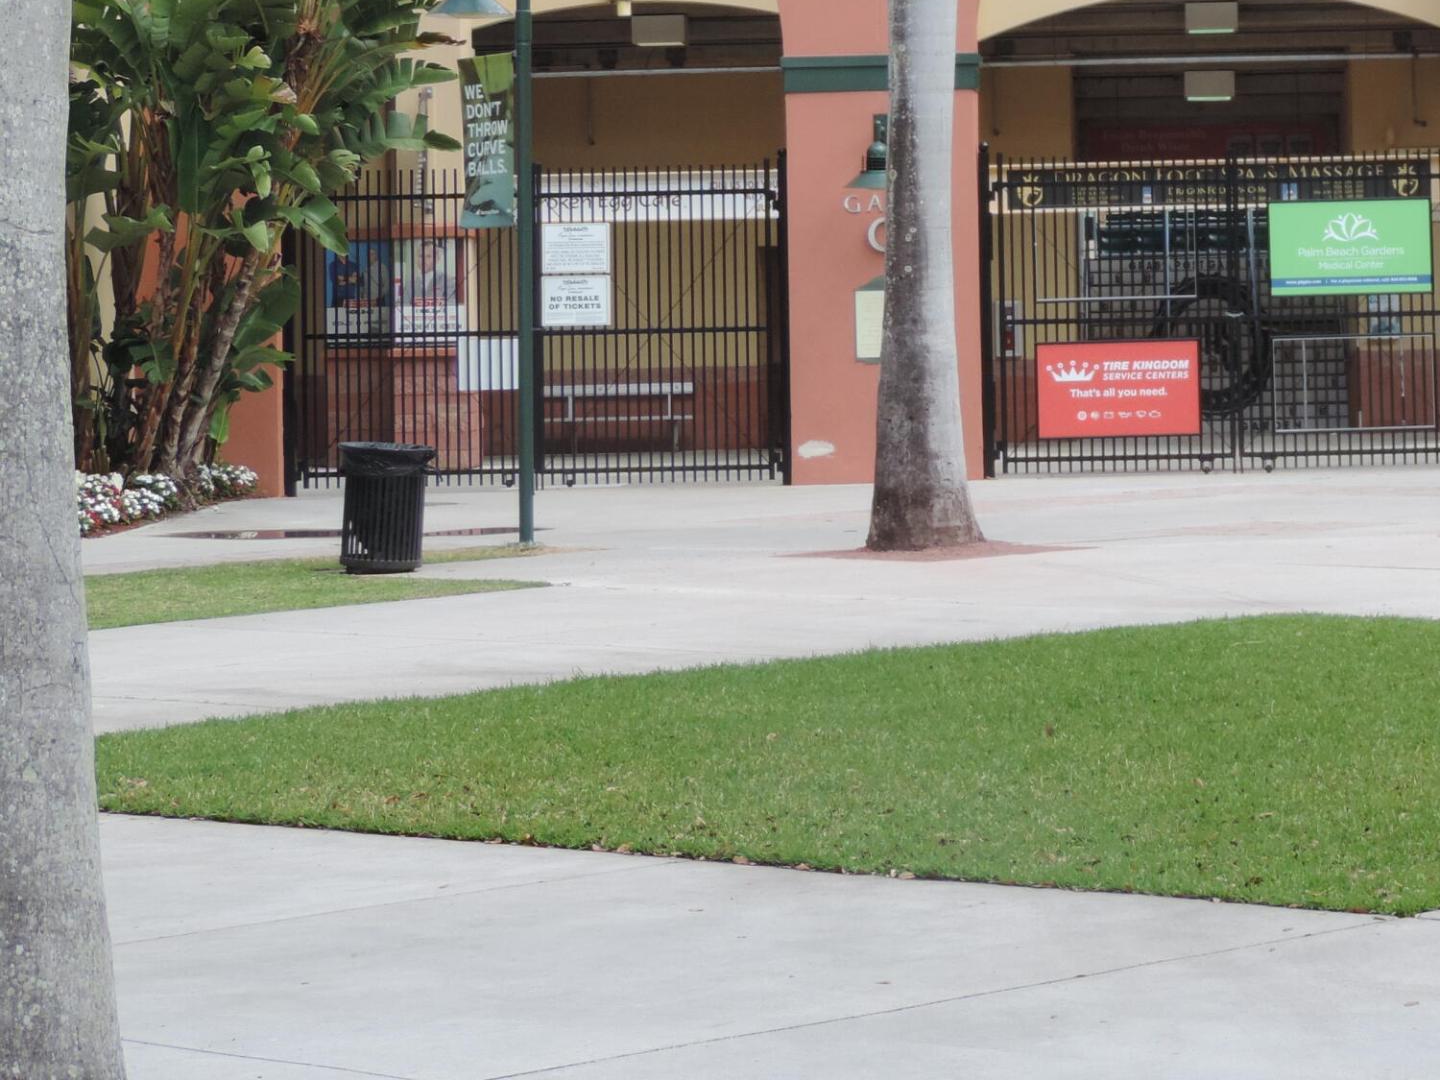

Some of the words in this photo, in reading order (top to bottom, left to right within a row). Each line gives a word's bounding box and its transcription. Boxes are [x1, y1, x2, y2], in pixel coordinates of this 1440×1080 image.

[465, 83, 483, 100] WE
[466, 101, 501, 119] DON'T
[467, 119, 508, 138] THROW
[468, 139, 506, 158] CURVE
[468, 159, 507, 177] BALLS.
[1297, 247, 1324, 258] Palm
[1326, 246, 1358, 257] Beach
[1361, 245, 1405, 256] Gardens
[1318, 260, 1353, 270] Medical
[1354, 259, 1384, 269] Center
[1102, 361, 1130, 371] TIRE
[1132, 359, 1190, 370] KINGDOM
[1102, 372, 1142, 381] SERVICE
[1145, 371, 1190, 380] CENTERS
[1070, 388, 1100, 398] That's
[1103, 387, 1115, 398] all
[1118, 388, 1137, 399] you
[1139, 387, 1168, 397] need.
